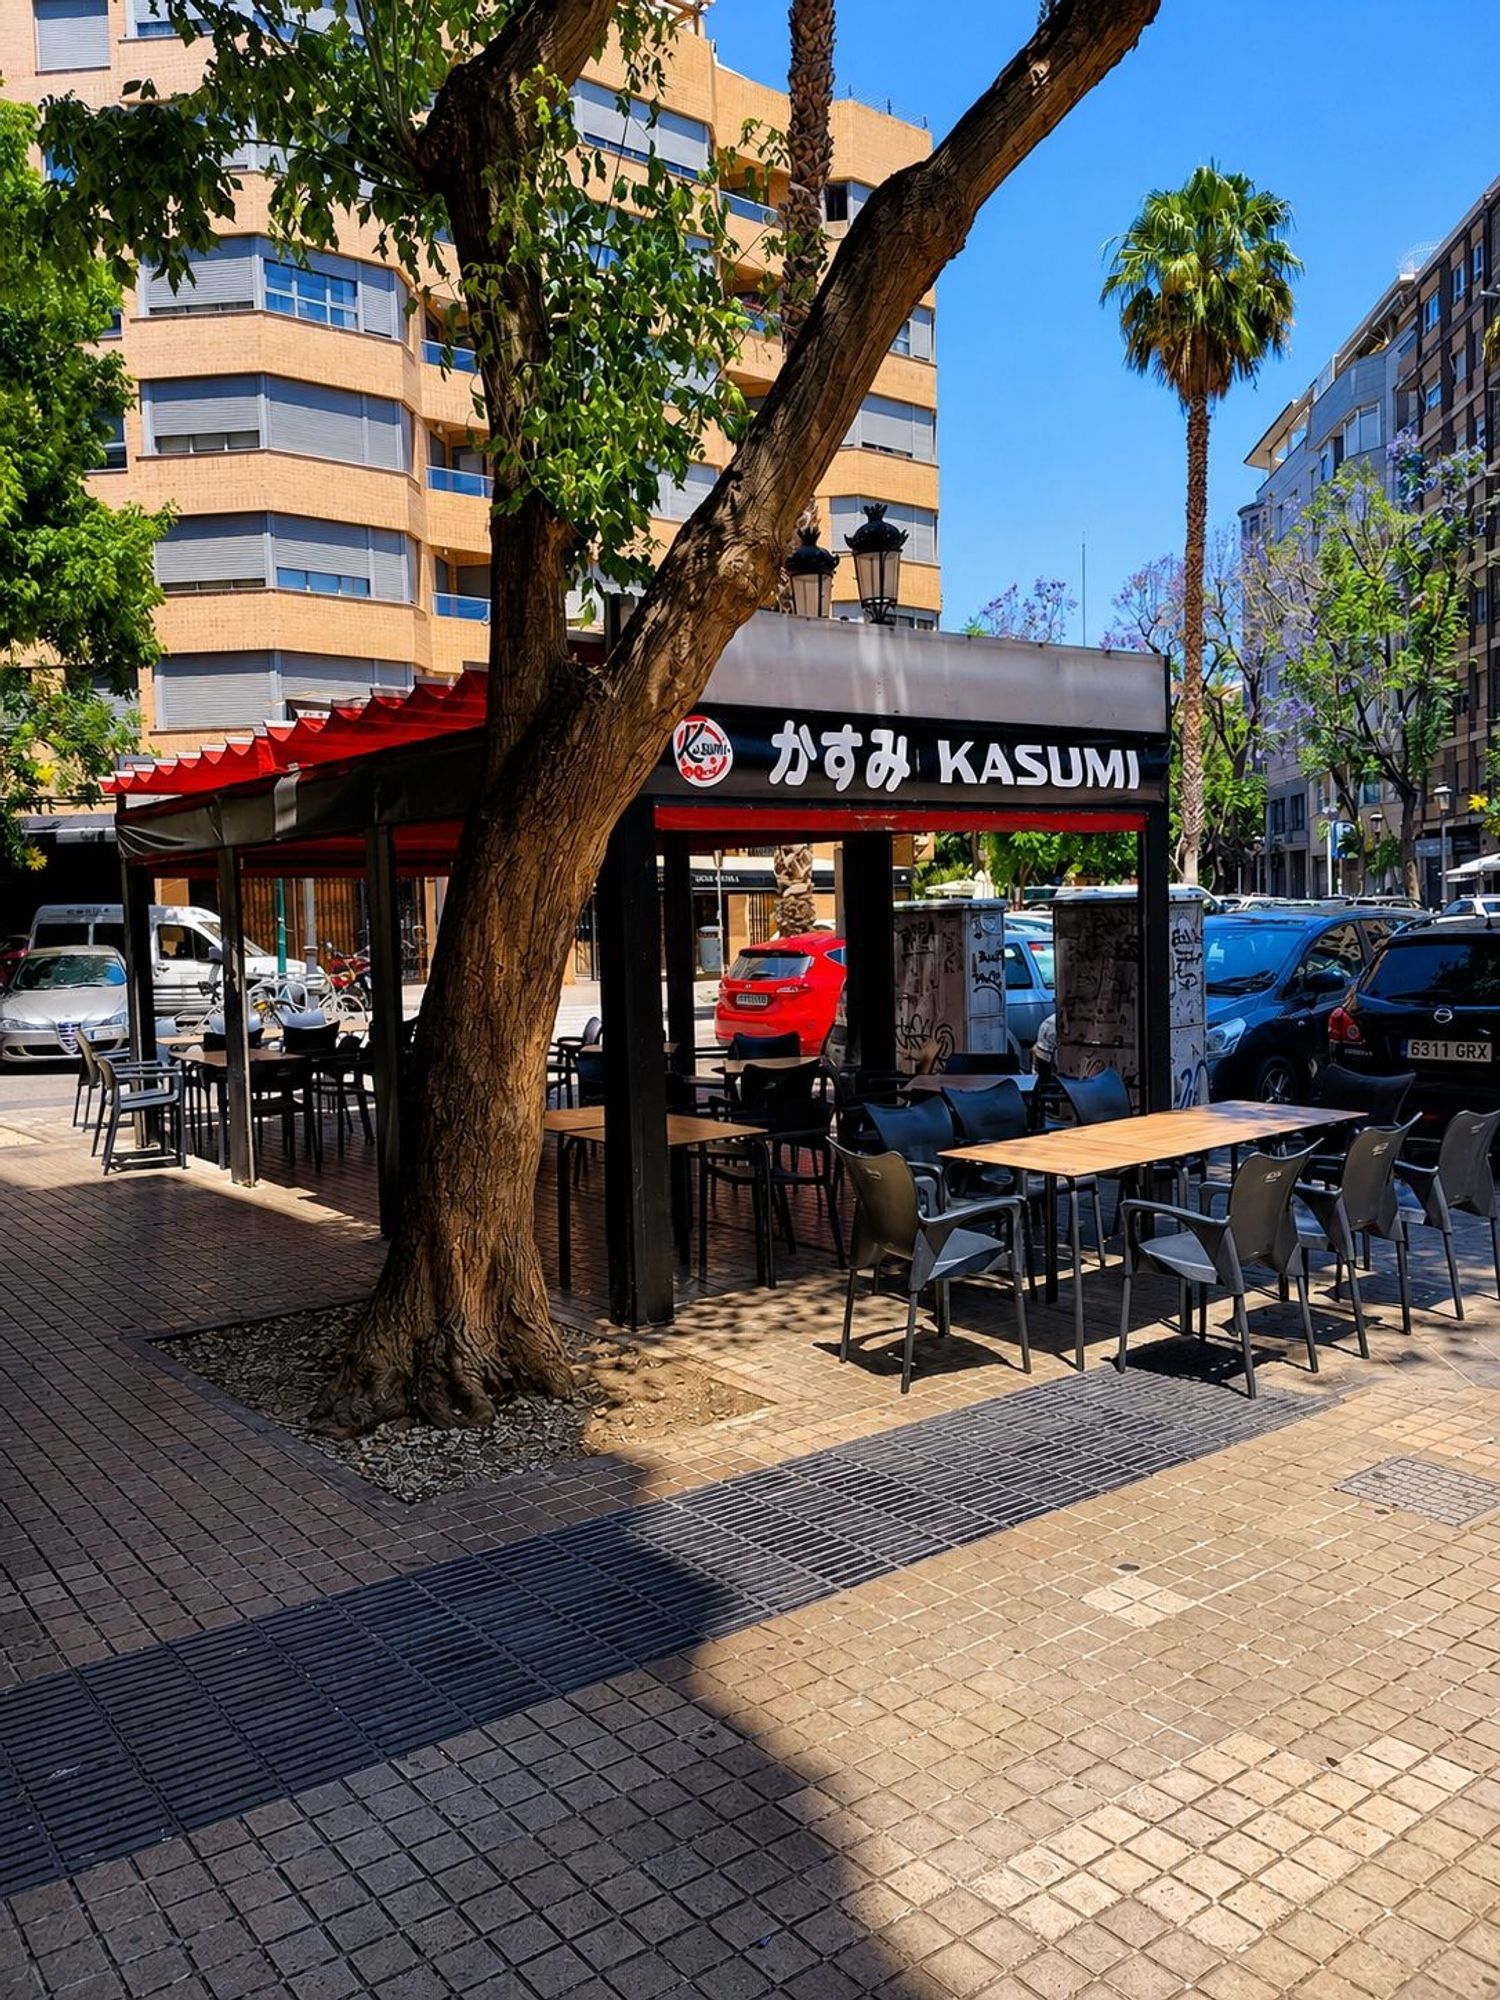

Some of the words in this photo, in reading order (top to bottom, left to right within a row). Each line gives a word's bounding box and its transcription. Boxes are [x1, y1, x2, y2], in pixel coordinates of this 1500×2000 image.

[768, 719, 911, 793] かすみ
[937, 739, 1141, 790] KASUMI
[1411, 1042, 1449, 1057] 6311
[1456, 1043, 1488, 1059] GRX
